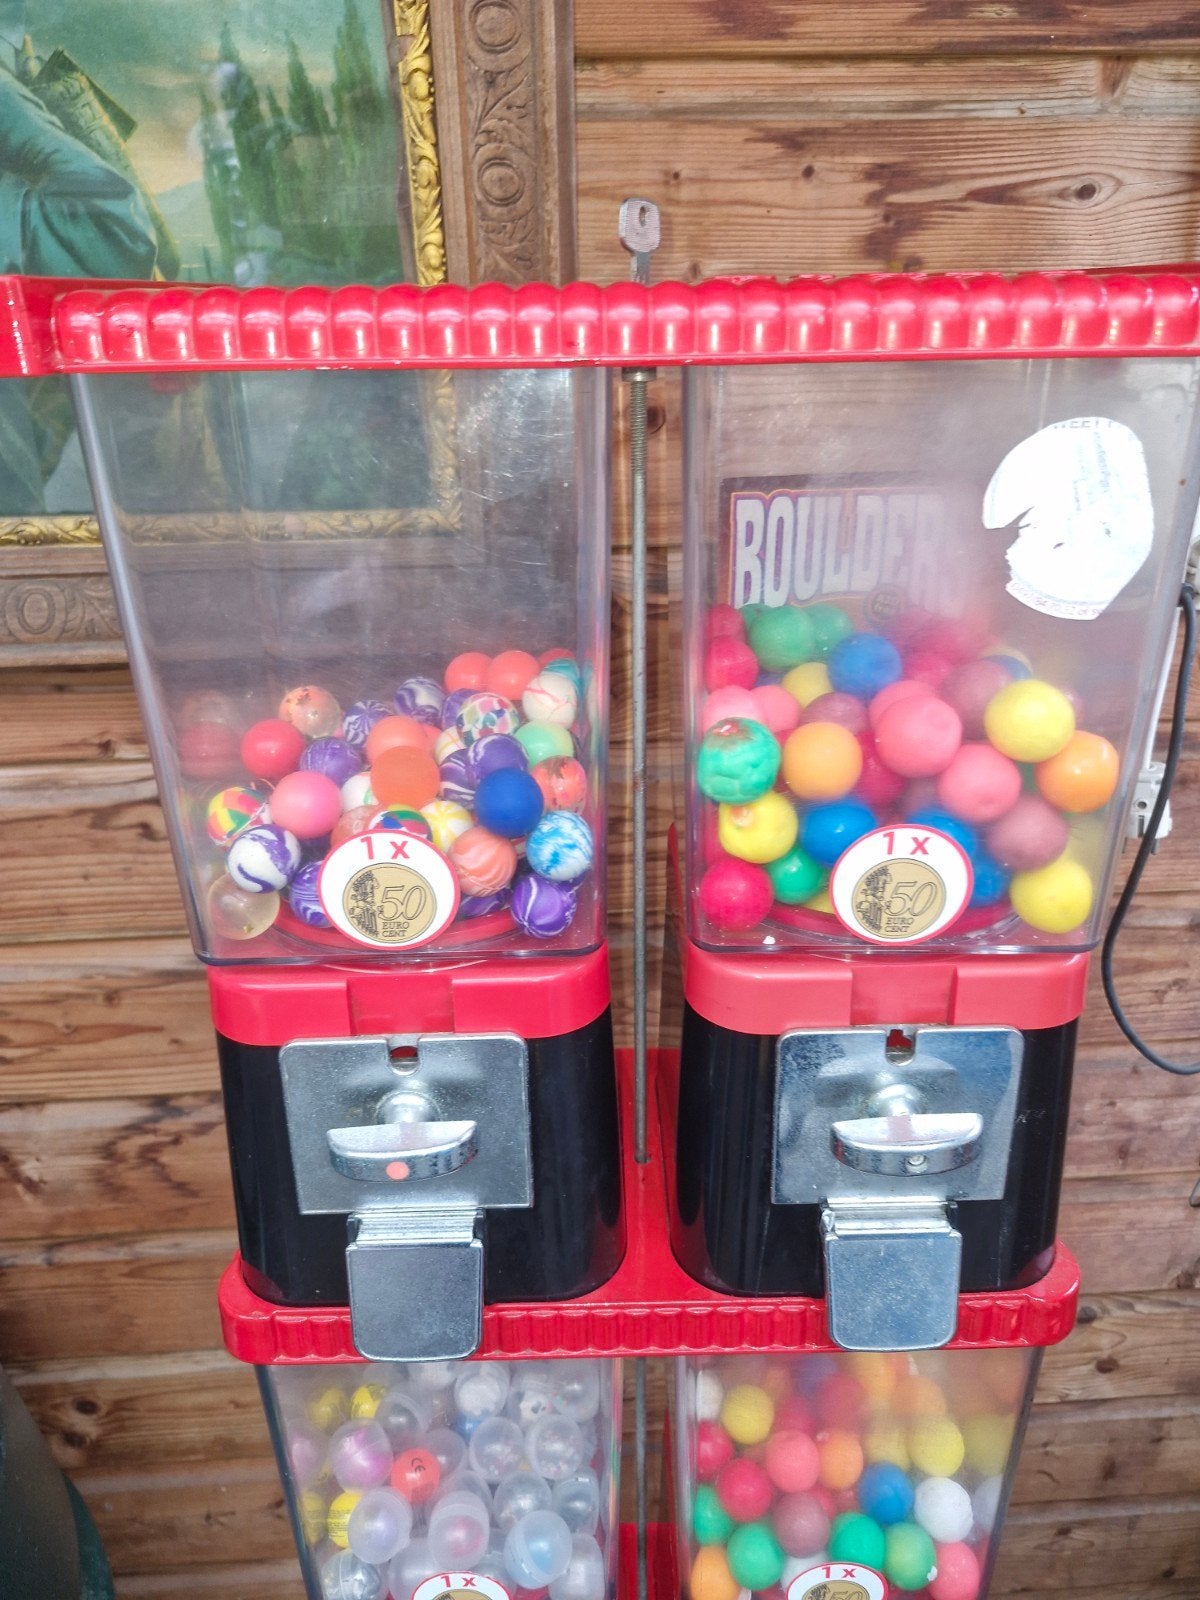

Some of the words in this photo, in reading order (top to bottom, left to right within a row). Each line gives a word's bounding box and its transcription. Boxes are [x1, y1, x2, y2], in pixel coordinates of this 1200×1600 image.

[360, 836, 374, 860] 1
[883, 831, 895, 855] 1
[377, 884, 427, 921] 50
[884, 881, 938, 916] 50
[382, 921, 410, 930] EURO
[886, 917, 913, 926] EURO
[382, 930, 407, 938] CENT
[822, 1567, 831, 1579] 1
[441, 1575, 451, 1588] 1
